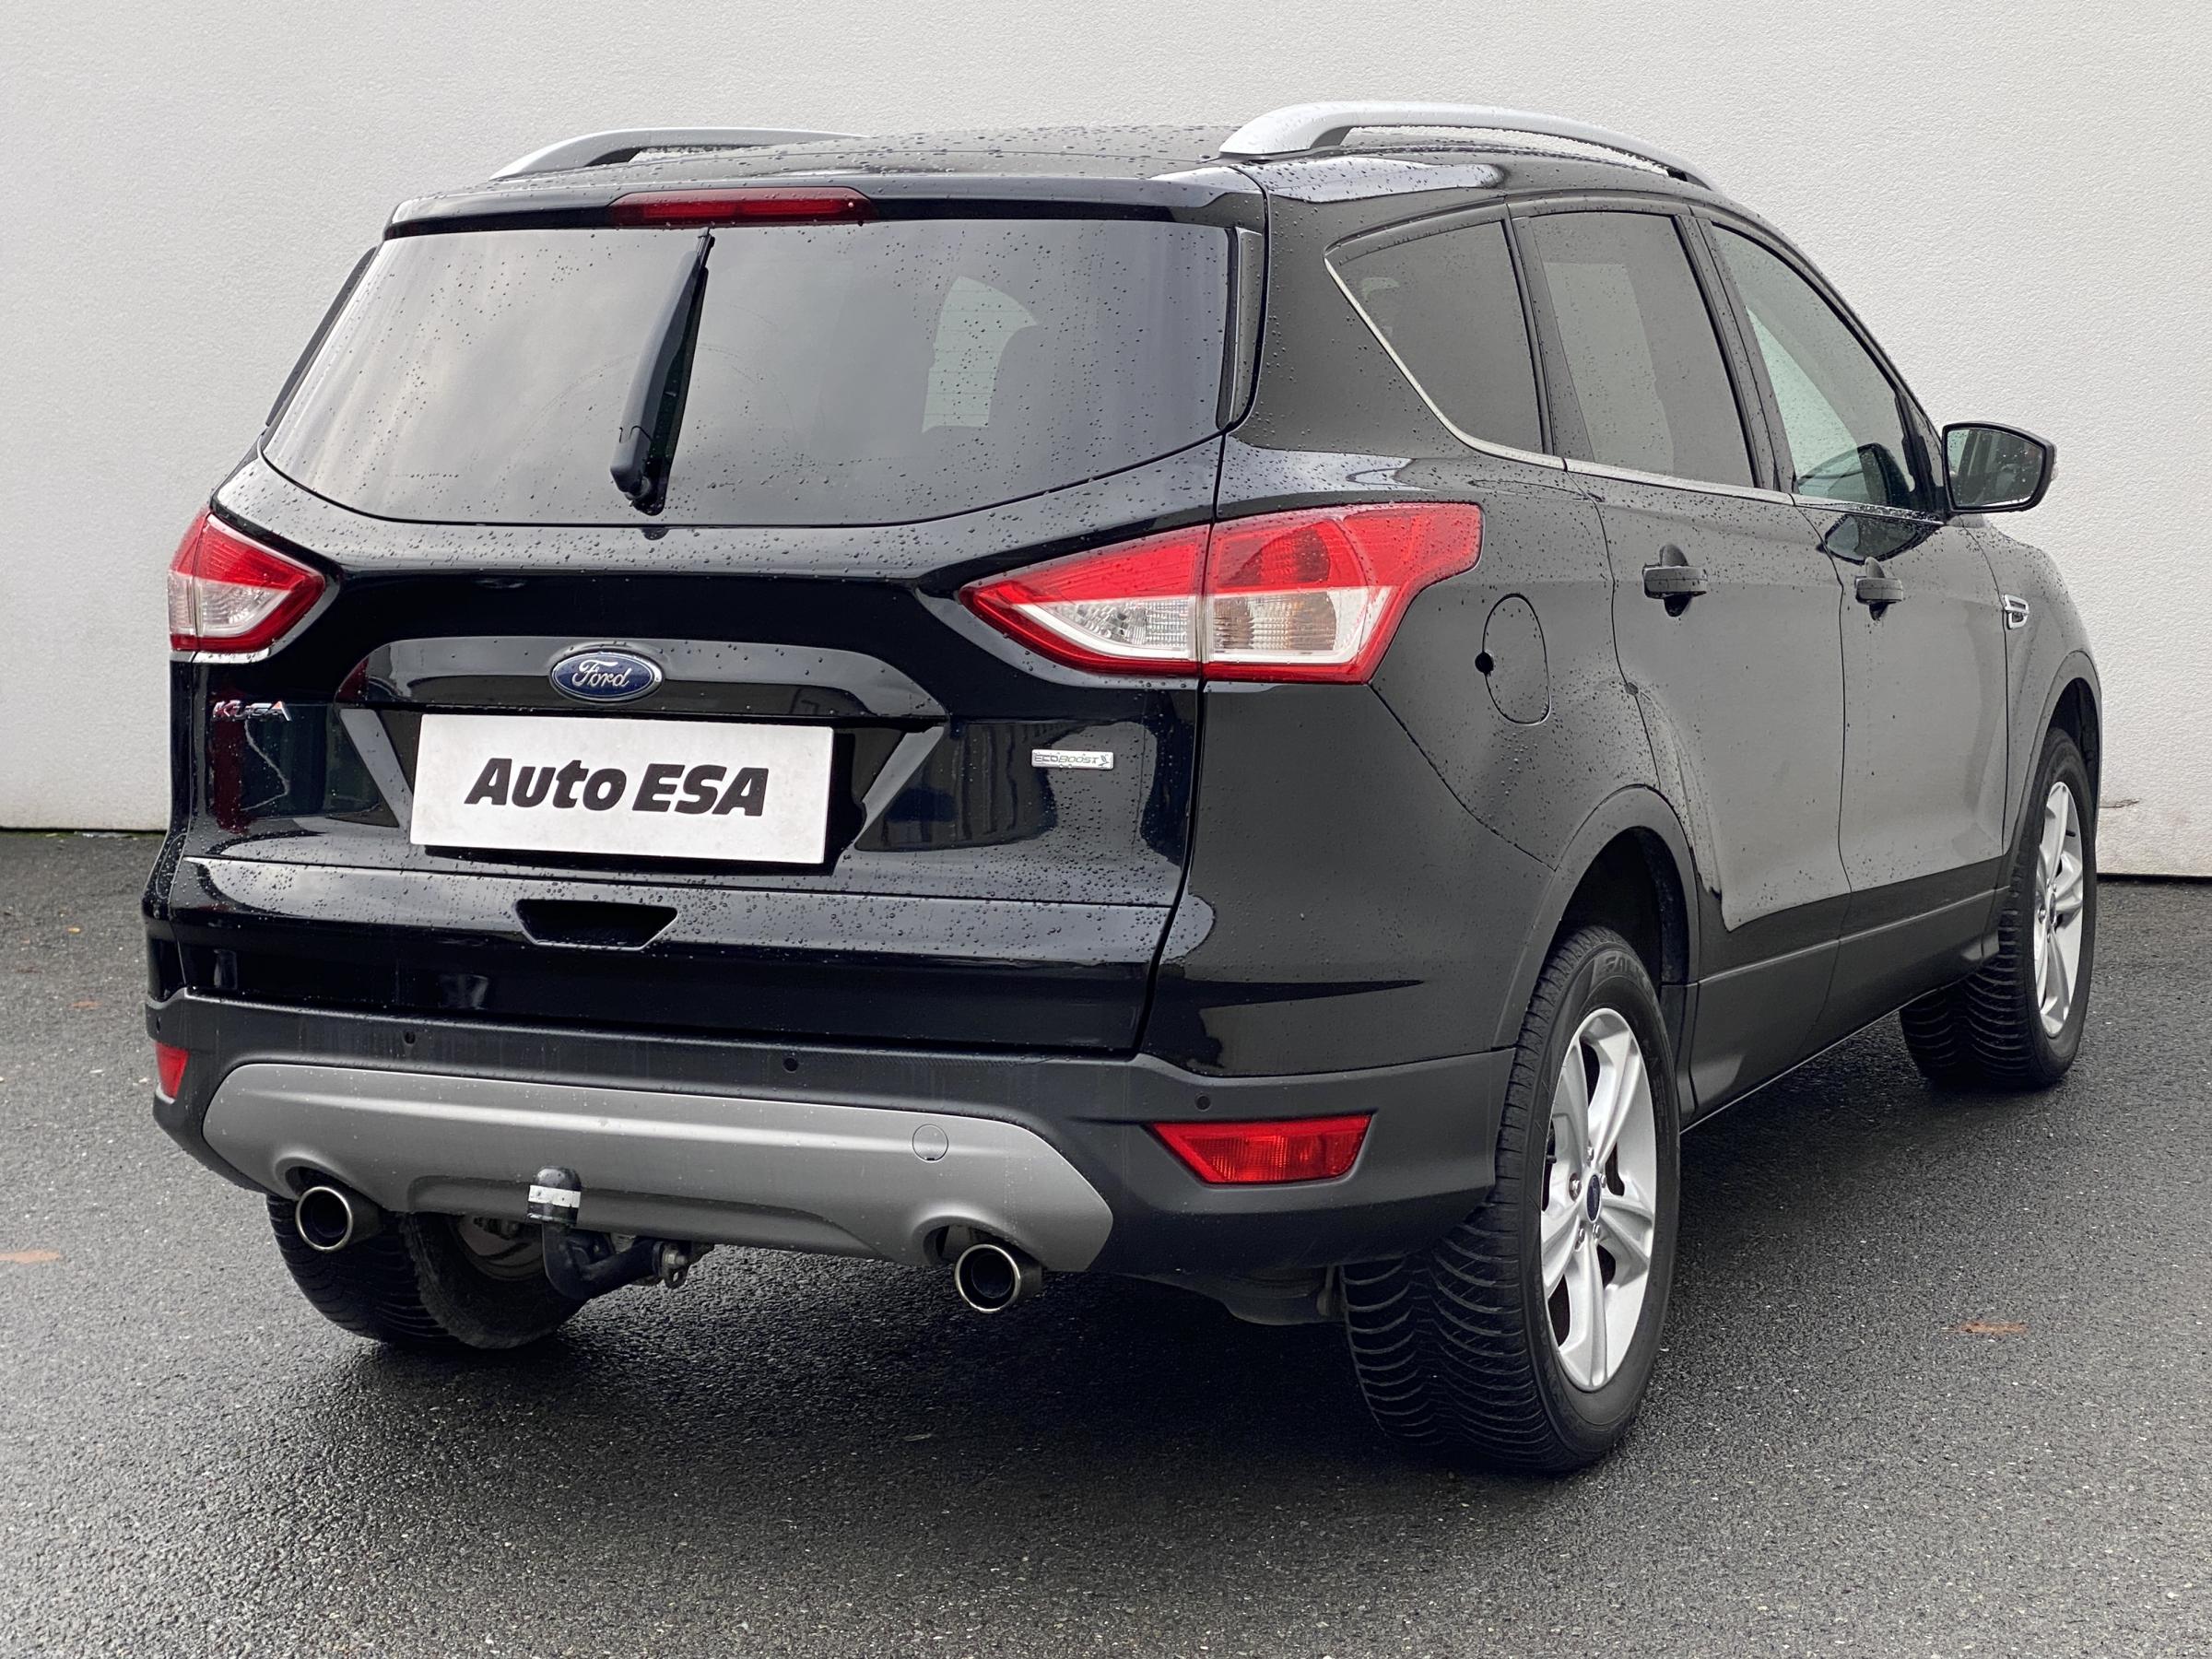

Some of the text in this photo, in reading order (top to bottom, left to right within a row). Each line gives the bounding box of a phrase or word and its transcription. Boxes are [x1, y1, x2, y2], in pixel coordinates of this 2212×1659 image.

[571, 659, 632, 688] Ford
[464, 758, 769, 817] Auto ESA
